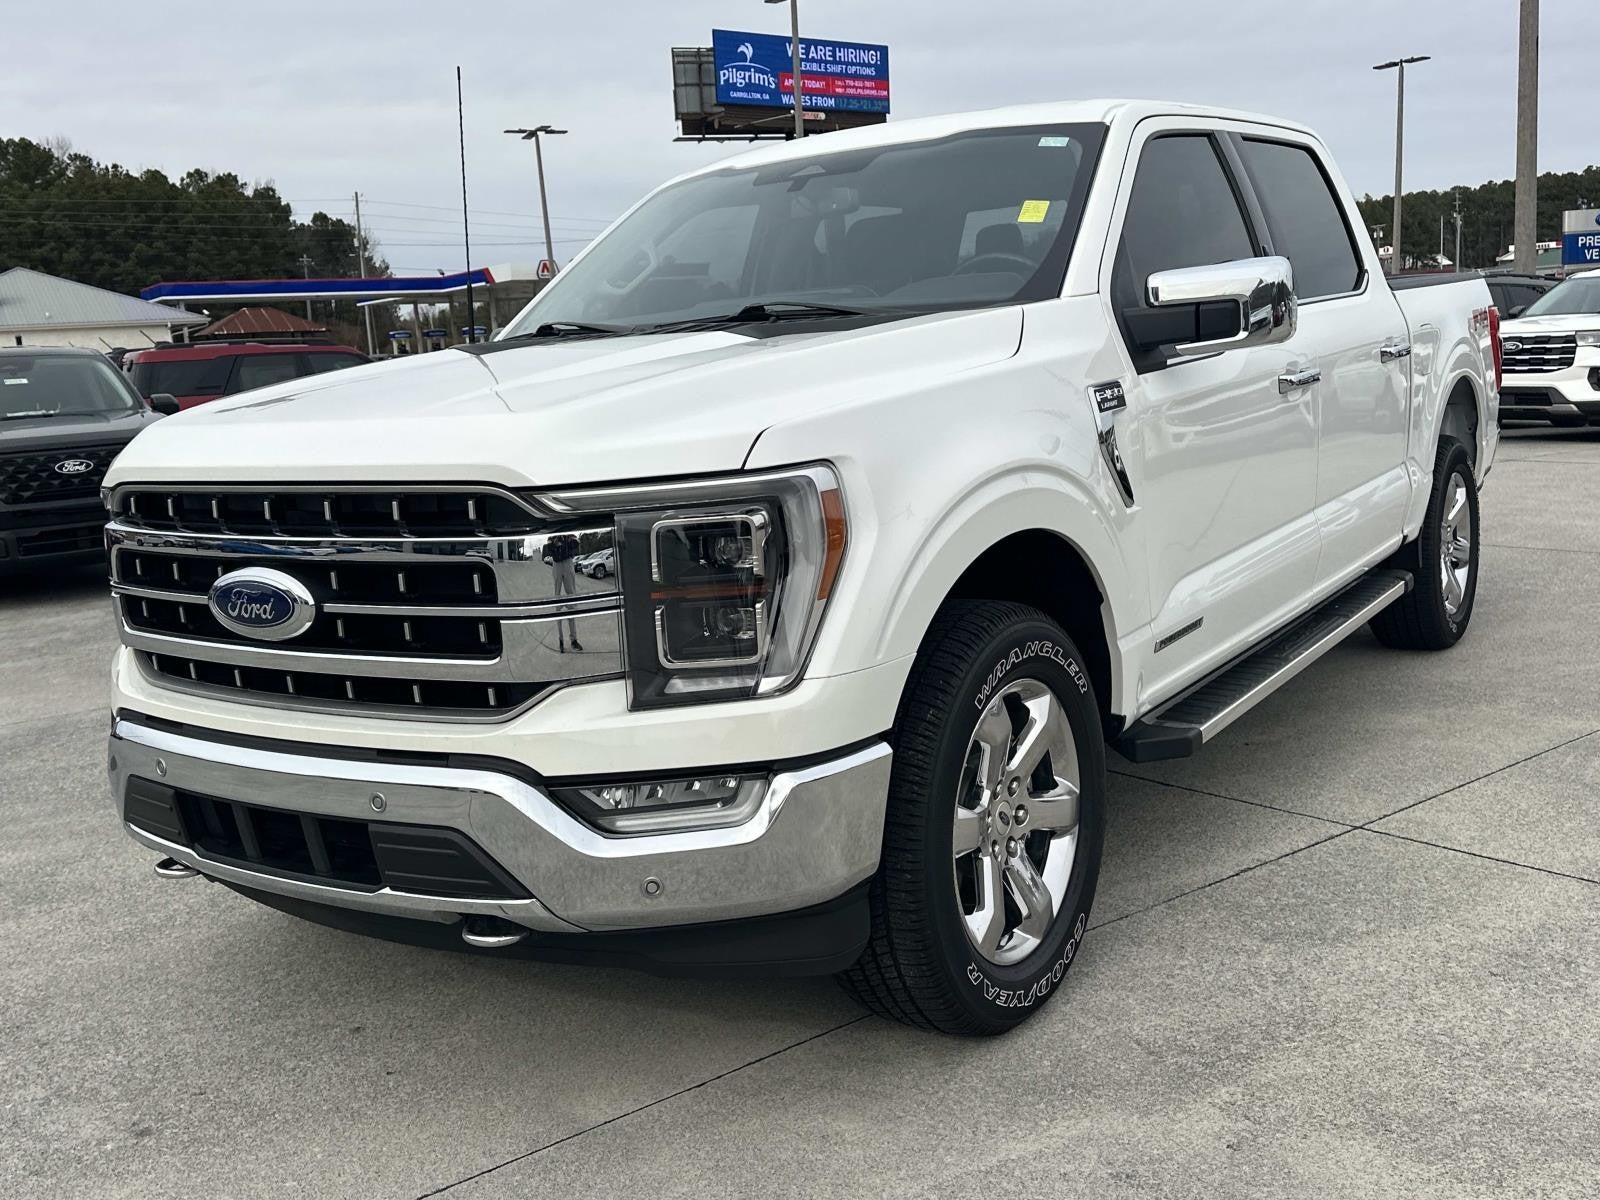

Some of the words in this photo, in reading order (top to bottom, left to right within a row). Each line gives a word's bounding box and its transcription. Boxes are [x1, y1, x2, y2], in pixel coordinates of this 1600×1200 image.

[809, 45, 833, 60] ARE
[836, 47, 881, 65] HIRING!
[800, 61, 825, 72] EXIBLE
[827, 63, 846, 74] SHIFT
[847, 65, 876, 76] OPTIONS
[720, 68, 776, 89] Pilgrim's
[804, 79, 826, 89] TODAY!
[781, 94, 811, 106] WAES
[812, 96, 835, 108] FROM
[1578, 235, 1600, 247] PRE
[1585, 248, 1600, 260] VE
[62, 461, 86, 472] Ford
[227, 587, 275, 620] Ford
[974, 640, 1088, 710] WRANGLER
[966, 912, 1086, 1008] GOODYEAR
